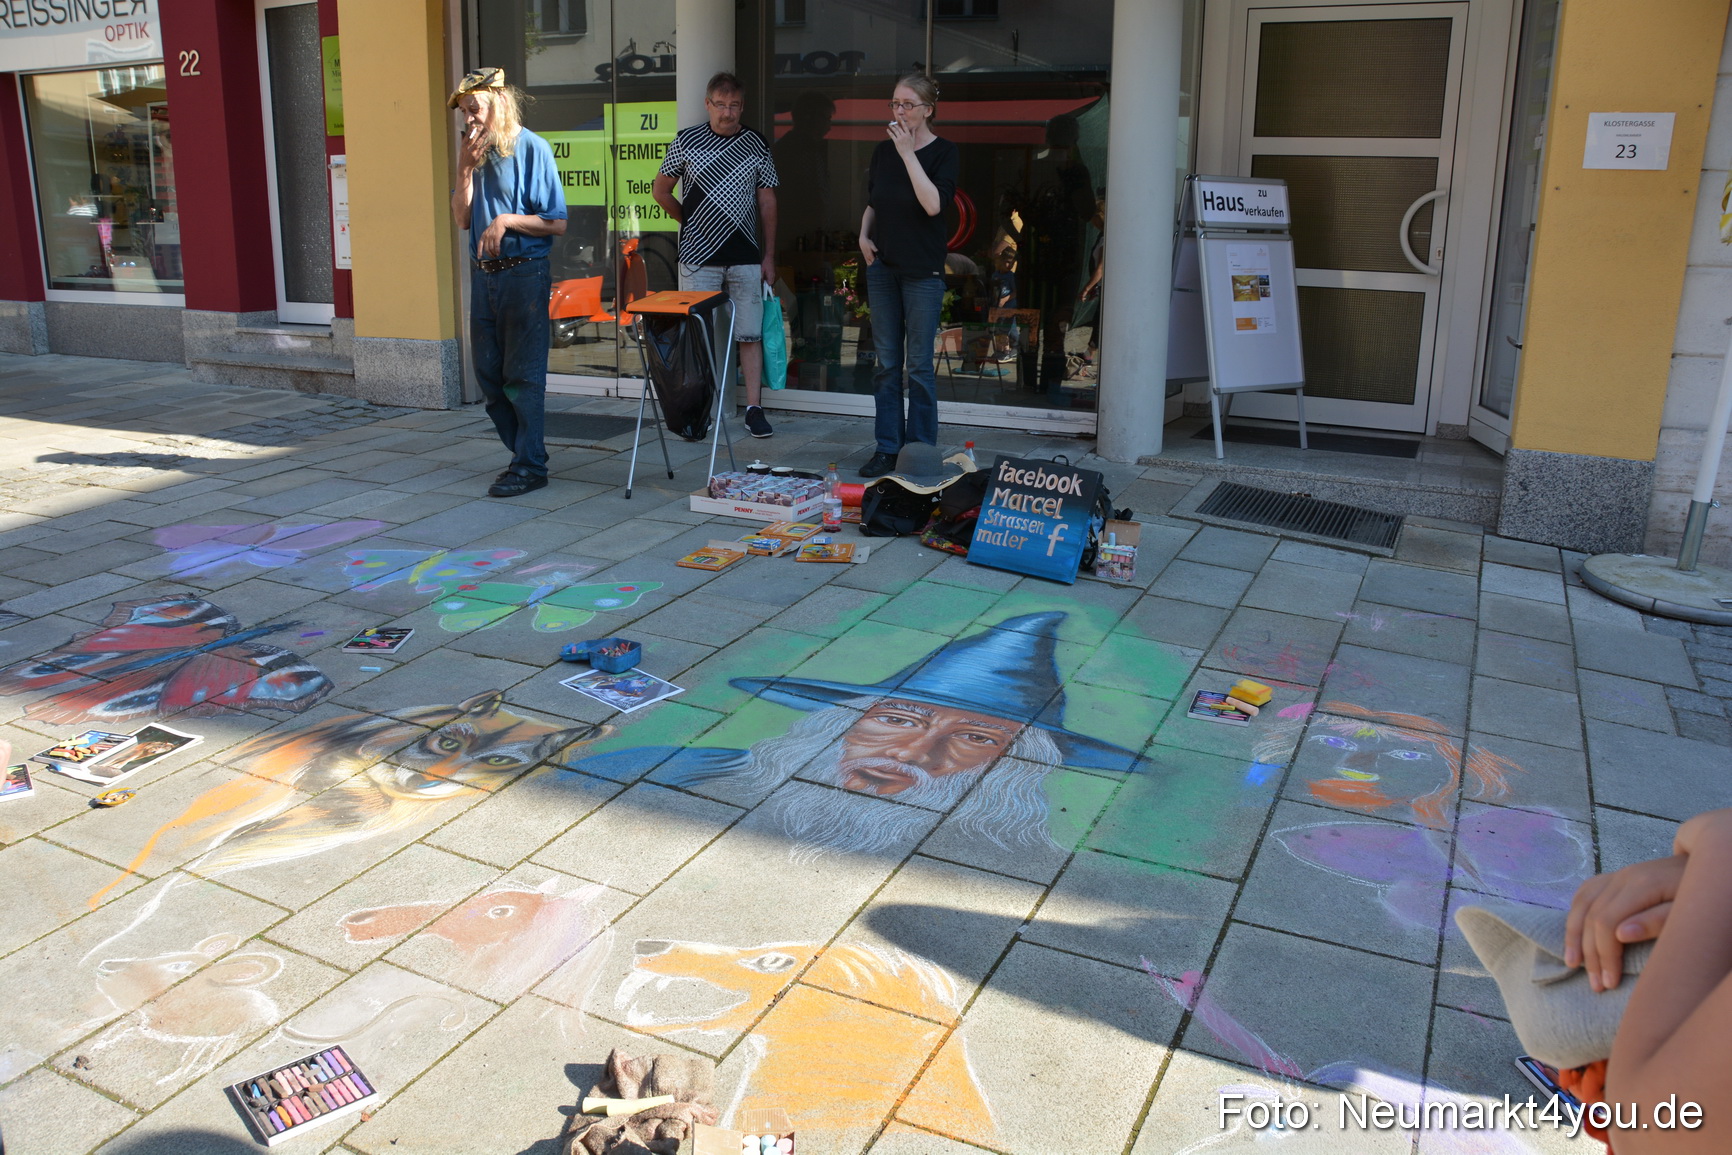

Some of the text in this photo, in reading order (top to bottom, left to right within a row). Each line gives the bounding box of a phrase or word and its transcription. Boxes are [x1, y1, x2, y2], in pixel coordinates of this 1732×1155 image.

[104, 21, 149, 42] OPTIK
[179, 50, 200, 76] 22
[640, 113, 658, 131] ZU
[1603, 120, 1656, 128] KLOSTERGASSE
[553, 142, 570, 159] ZU
[609, 142, 672, 161] VERMIET
[1615, 144, 1637, 159] 23
[626, 178, 656, 194] Telef
[1258, 189, 1267, 198] zu
[1202, 190, 1245, 212] Haus
[1244, 205, 1285, 218] verkaufen
[997, 460, 1083, 497] facebook
[734, 506, 753, 514] PENNY
[988, 487, 1064, 520] Marcel
[984, 508, 1046, 536] Strassen
[976, 528, 1029, 550] maler
